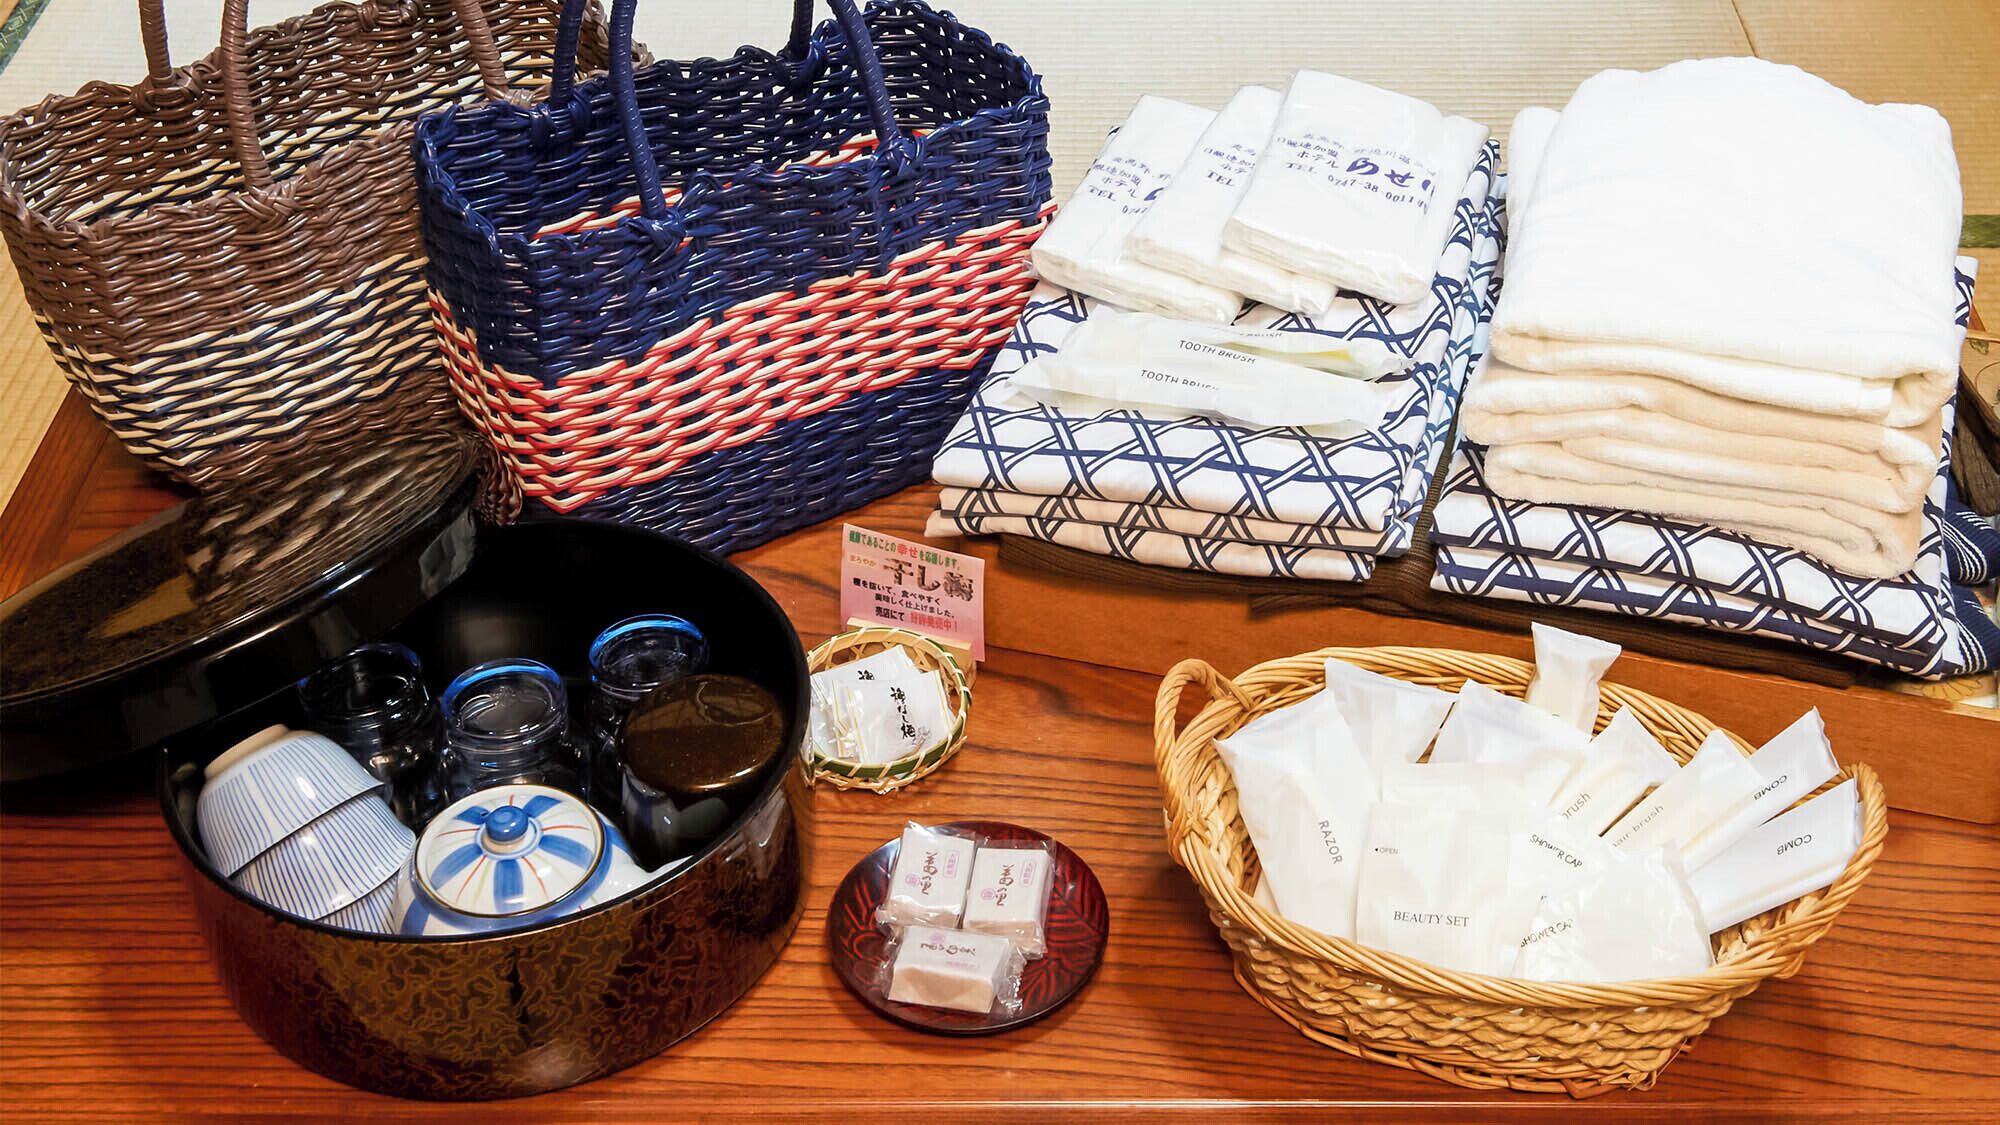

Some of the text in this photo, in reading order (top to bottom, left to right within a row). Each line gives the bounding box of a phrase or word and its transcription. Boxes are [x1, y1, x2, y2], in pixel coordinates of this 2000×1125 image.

[1286, 162, 1317, 173] TEL
[1297, 150, 1339, 169] ホテル
[1207, 169, 1235, 186] TEL
[1090, 184, 1116, 202] TEL
[1103, 177, 1137, 198] ホテル
[1178, 339, 1257, 364] TOOTH BRUSH
[1141, 369, 1179, 384] TOOTH
[875, 606, 905, 622] 売店にて
[1753, 774, 1788, 801] COMB
[1632, 805, 1664, 832] brush
[1318, 819, 1342, 865] RAZOR
[1379, 847, 1398, 855] OPEN
[1776, 833, 1813, 856] COMB
[1565, 853, 1583, 868] CAP
[1393, 910, 1470, 928] BEAUTY SET
